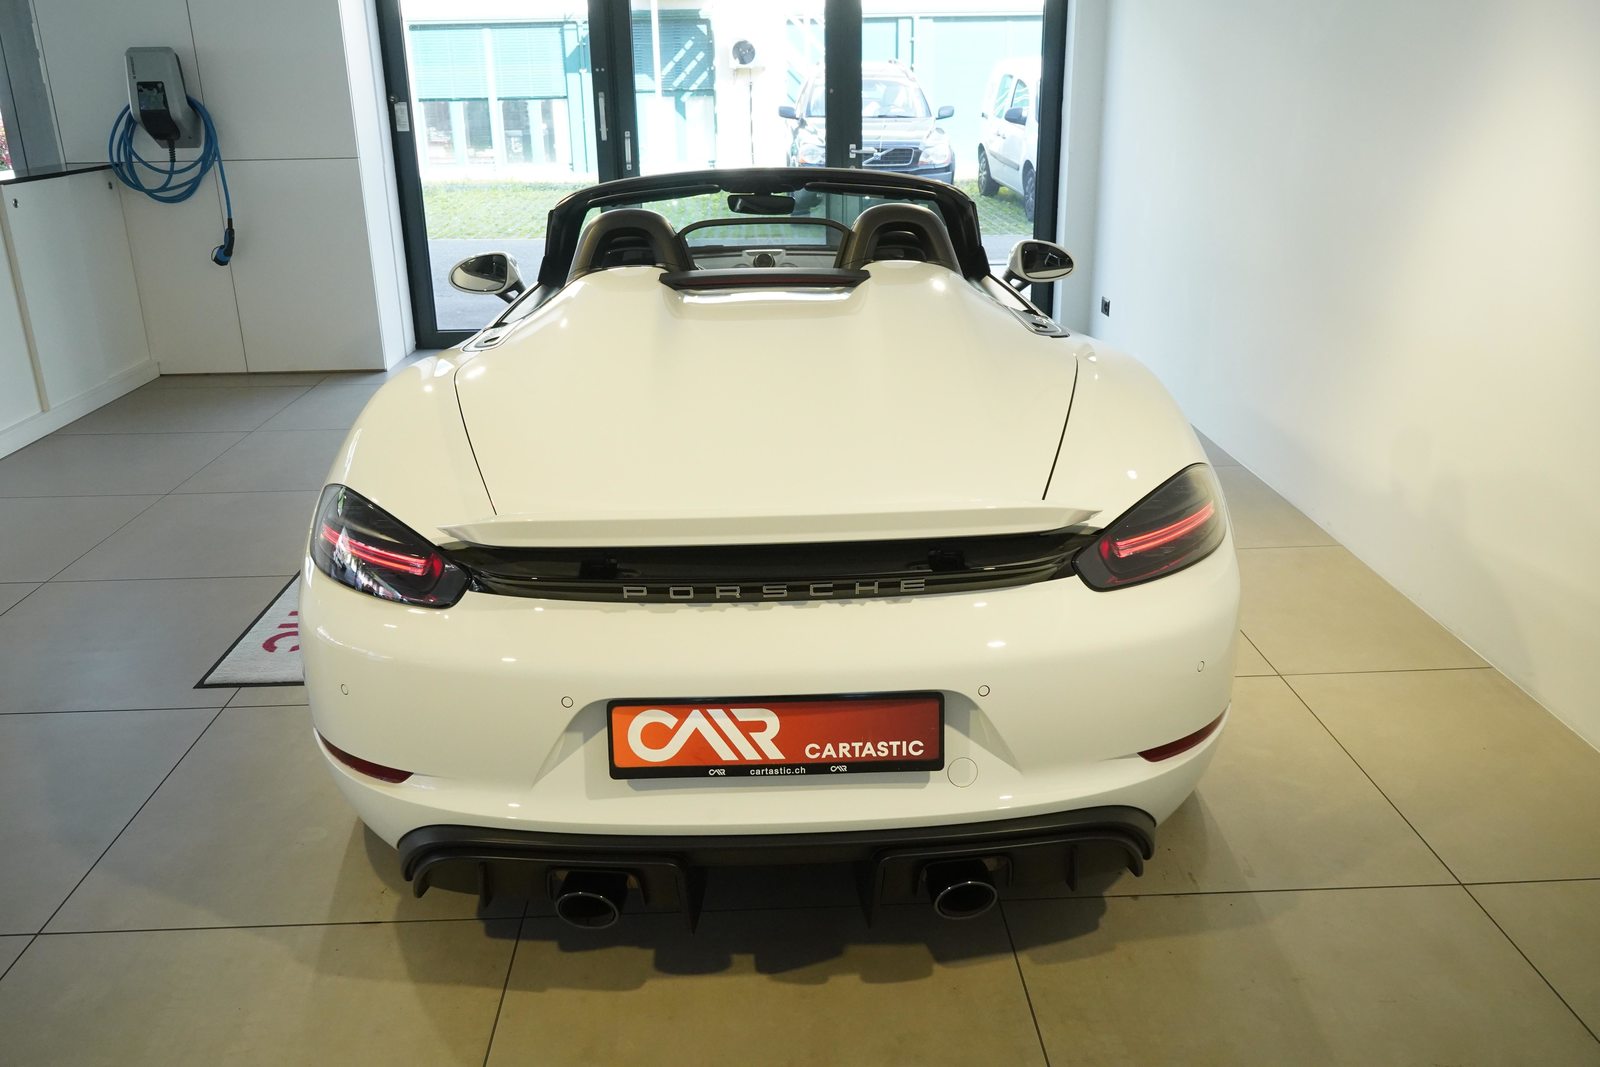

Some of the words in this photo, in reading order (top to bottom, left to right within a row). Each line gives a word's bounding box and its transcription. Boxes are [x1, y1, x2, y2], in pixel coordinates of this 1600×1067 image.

[623, 578, 926, 599] PORSCHE
[804, 740, 924, 759] CARTASTIC
[750, 766, 806, 776] cartastic.ch
